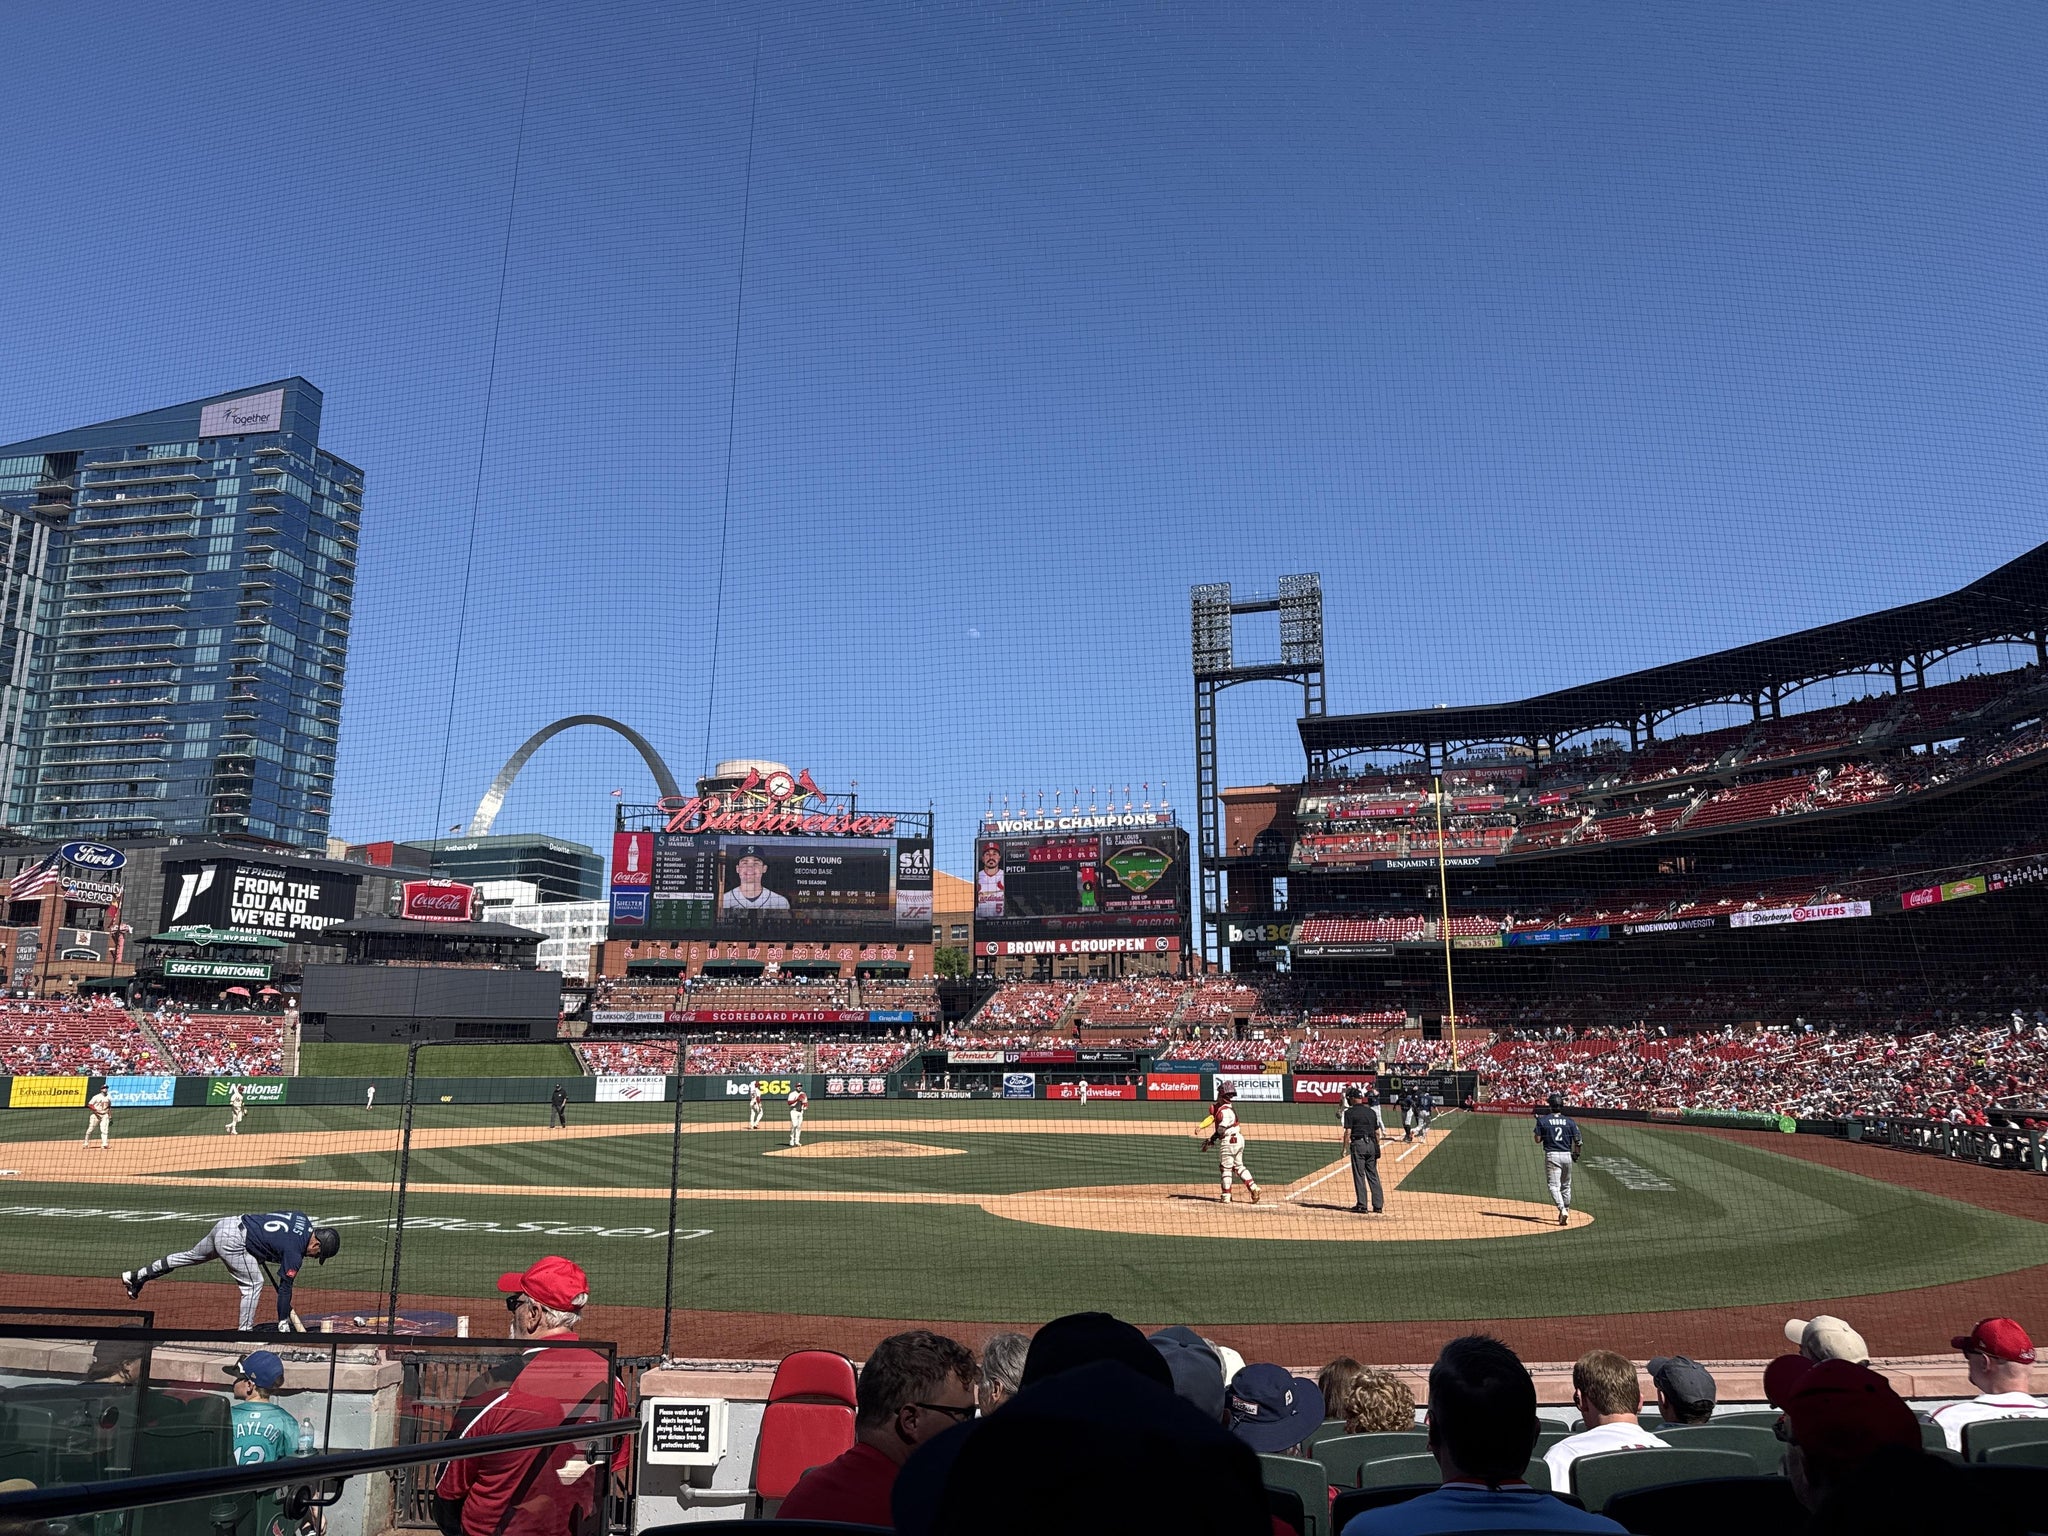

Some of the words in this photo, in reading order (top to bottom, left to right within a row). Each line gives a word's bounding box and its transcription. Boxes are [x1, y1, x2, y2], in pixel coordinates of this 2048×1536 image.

[232, 413, 270, 426] Together
[658, 795, 897, 834] Budweiser
[996, 820, 1054, 832] WORLD
[1058, 814, 1157, 829] CHAMPIONS
[74, 845, 114, 866] Ford
[795, 856, 814, 864] COLE
[816, 856, 842, 865] YOUNG
[1386, 860, 1428, 868] BENJAMIN
[1430, 859, 1436, 867] F.
[614, 872, 650, 884] Coca-Cola
[62, 877, 123, 894] Community
[234, 876, 284, 895] FROM
[288, 883, 320, 900] THE
[232, 892, 266, 910] LOU
[270, 897, 306, 914] AND
[412, 892, 463, 910] Coca-Cola
[230, 908, 286, 927] WE'RE
[290, 914, 345, 931] PROU
[1752, 912, 1792, 924] Dierbergs
[1793, 907, 1846, 920] DELIVERS
[1635, 922, 1678, 933] LINDENWOOD
[1678, 918, 1716, 930] UNIVERSITY
[1228, 924, 1290, 942] bet36
[659, 948, 668, 960] 2
[674, 948, 683, 960] 6
[690, 948, 698, 960] 9
[707, 948, 720, 960] 10
[727, 948, 740, 960] 14
[748, 948, 760, 960] 17
[767, 948, 783, 960] 20
[792, 948, 808, 960] 23
[815, 948, 830, 960] 24
[838, 948, 853, 960] 42
[861, 948, 876, 960] 45
[882, 948, 897, 960] 85
[1007, 941, 1056, 954] BROWN
[1060, 943, 1068, 952] &
[170, 964, 212, 974] SAFETY
[212, 965, 265, 977] NATIONAL
[712, 1012, 787, 1021] SCOREBOARD
[952, 1051, 998, 1060] Schnucks
[1006, 1054, 1019, 1063] UP
[1010, 1076, 1028, 1085] Ford
[1233, 1080, 1280, 1088] ERFICIENT
[19, 1088, 52, 1096] Edward
[52, 1088, 80, 1096] Jones
[229, 1082, 284, 1095] Ntional.
[831, 1083, 840, 1092] 66
[851, 1083, 860, 1092] 66
[871, 1083, 881, 1092] 66
[1074, 1088, 1122, 1096] Bdweiser
[1554, 1128, 1563, 1142] 2
[676, 1417, 692, 1425] leaving
[237, 1422, 280, 1444] AYLOR
[656, 1425, 672, 1433] playing
[234, 1446, 264, 1466] 12
